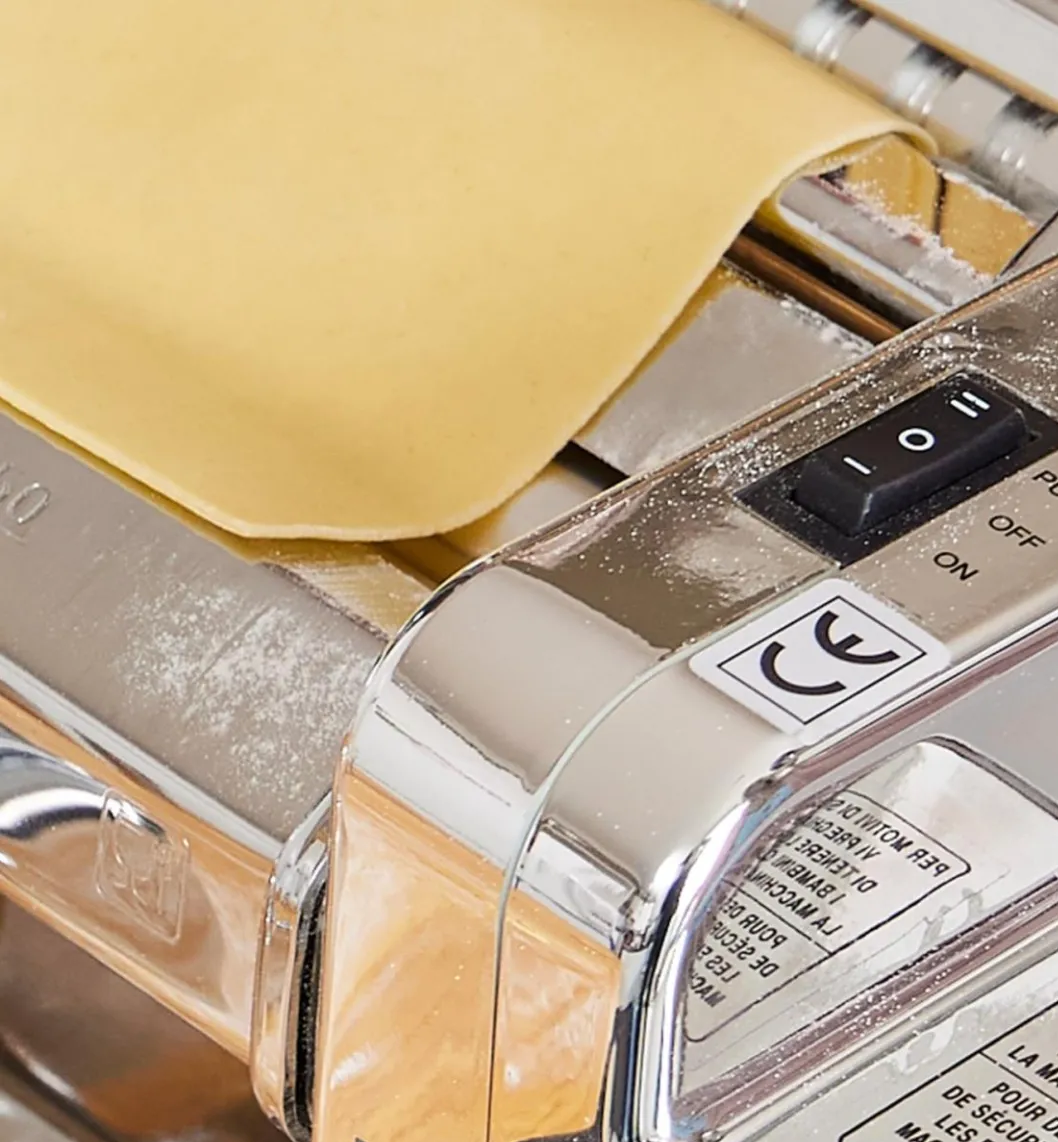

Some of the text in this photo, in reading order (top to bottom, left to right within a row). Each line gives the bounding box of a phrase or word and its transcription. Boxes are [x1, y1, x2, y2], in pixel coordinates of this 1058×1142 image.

[988, 514, 1047, 551] OFF
[932, 551, 980, 582] ON
[759, 610, 901, 697] CE
[1007, 1044, 1040, 1069] LA
[941, 1084, 978, 1109] DE
[987, 1081, 1048, 1122] POUR
